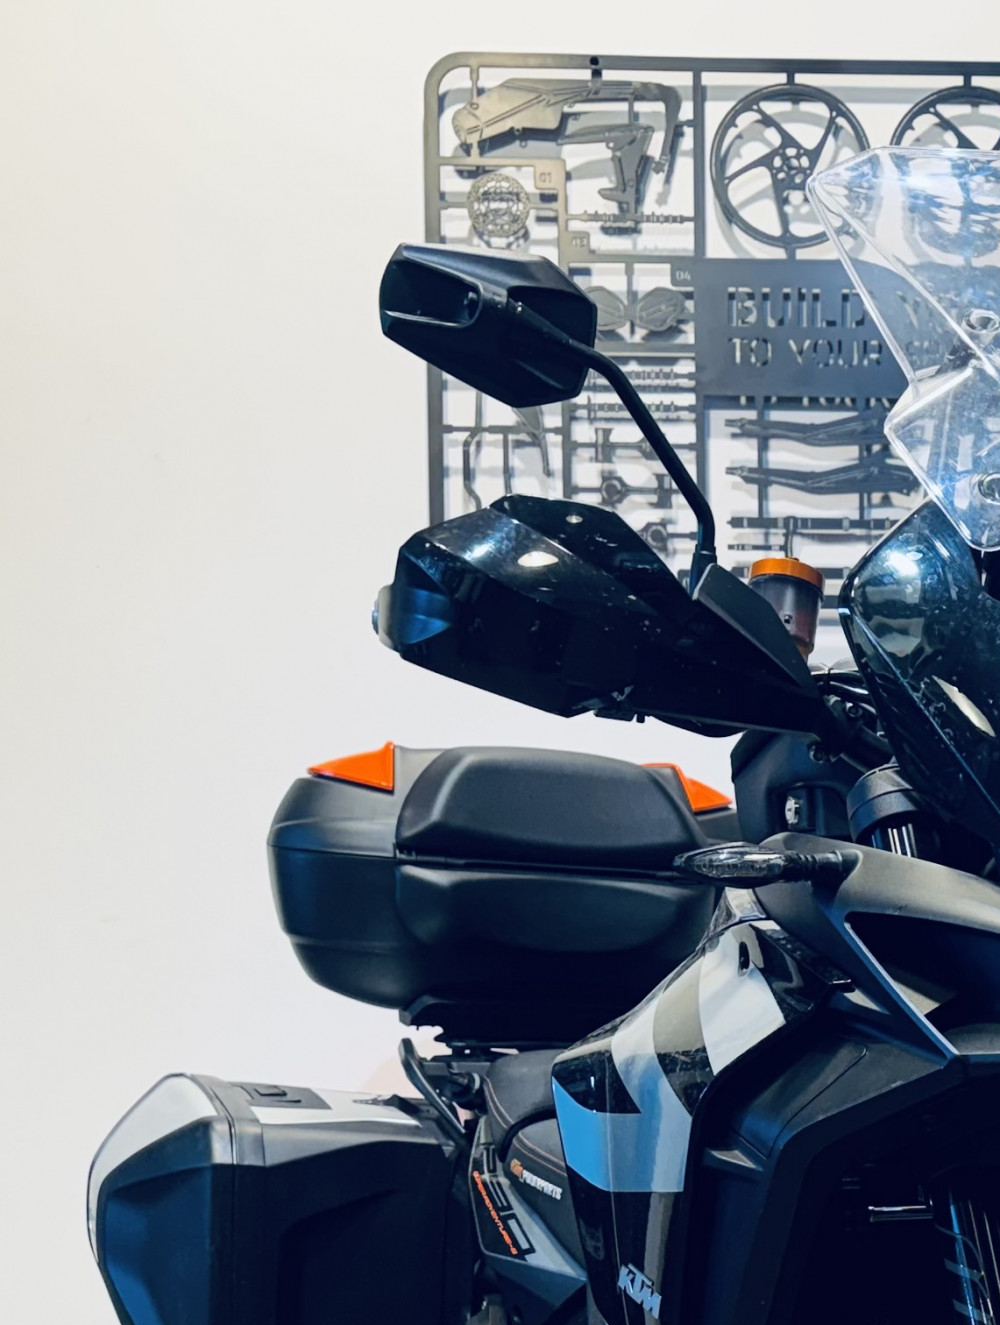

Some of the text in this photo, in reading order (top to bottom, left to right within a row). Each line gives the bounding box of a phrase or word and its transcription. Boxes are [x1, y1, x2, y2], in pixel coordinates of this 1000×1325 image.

[676, 270, 691, 281] 04
[727, 285, 868, 328] BUILD
[728, 337, 773, 368] TO
[788, 338, 883, 368] YOUR
[617, 1262, 662, 1320] KTM
